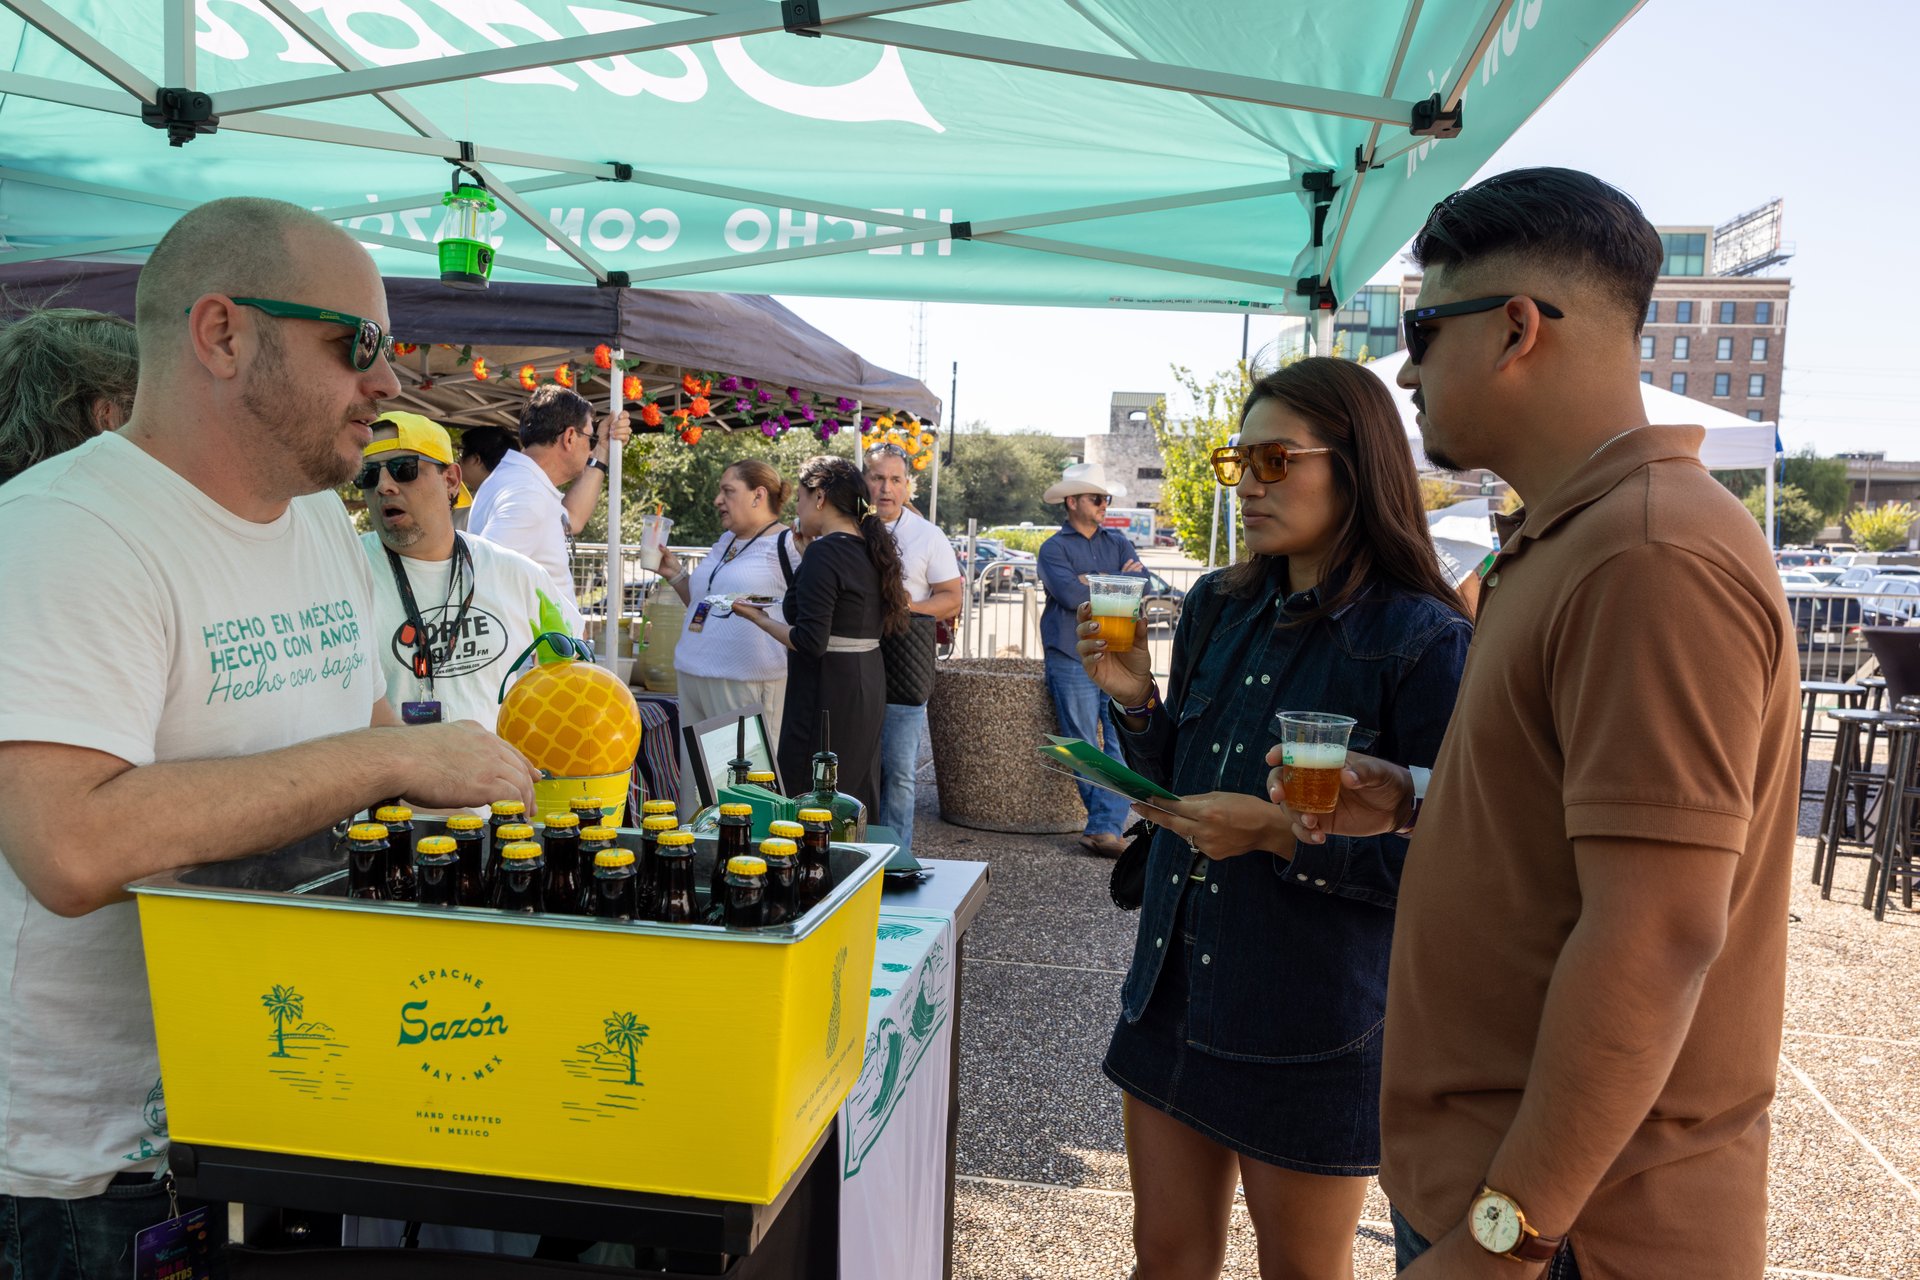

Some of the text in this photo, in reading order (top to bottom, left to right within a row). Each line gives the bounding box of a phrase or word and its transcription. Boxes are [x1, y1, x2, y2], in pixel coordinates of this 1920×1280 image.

[202, 616, 266, 648] HECHO
[270, 612, 295, 635] EN
[416, 616, 490, 646] ORTE
[211, 622, 361, 674] HECHO CON AMOR
[477, 648, 489, 656] FM
[206, 658, 286, 705] Hecho
[290, 667, 317, 687] con
[409, 968, 484, 990] TEPACHE
[397, 1000, 509, 1047] Sazón
[421, 1055, 503, 1082] NAY MEX
[416, 1111, 502, 1125] HAND CRAFTED
[448, 1127, 490, 1137] MEXICO
